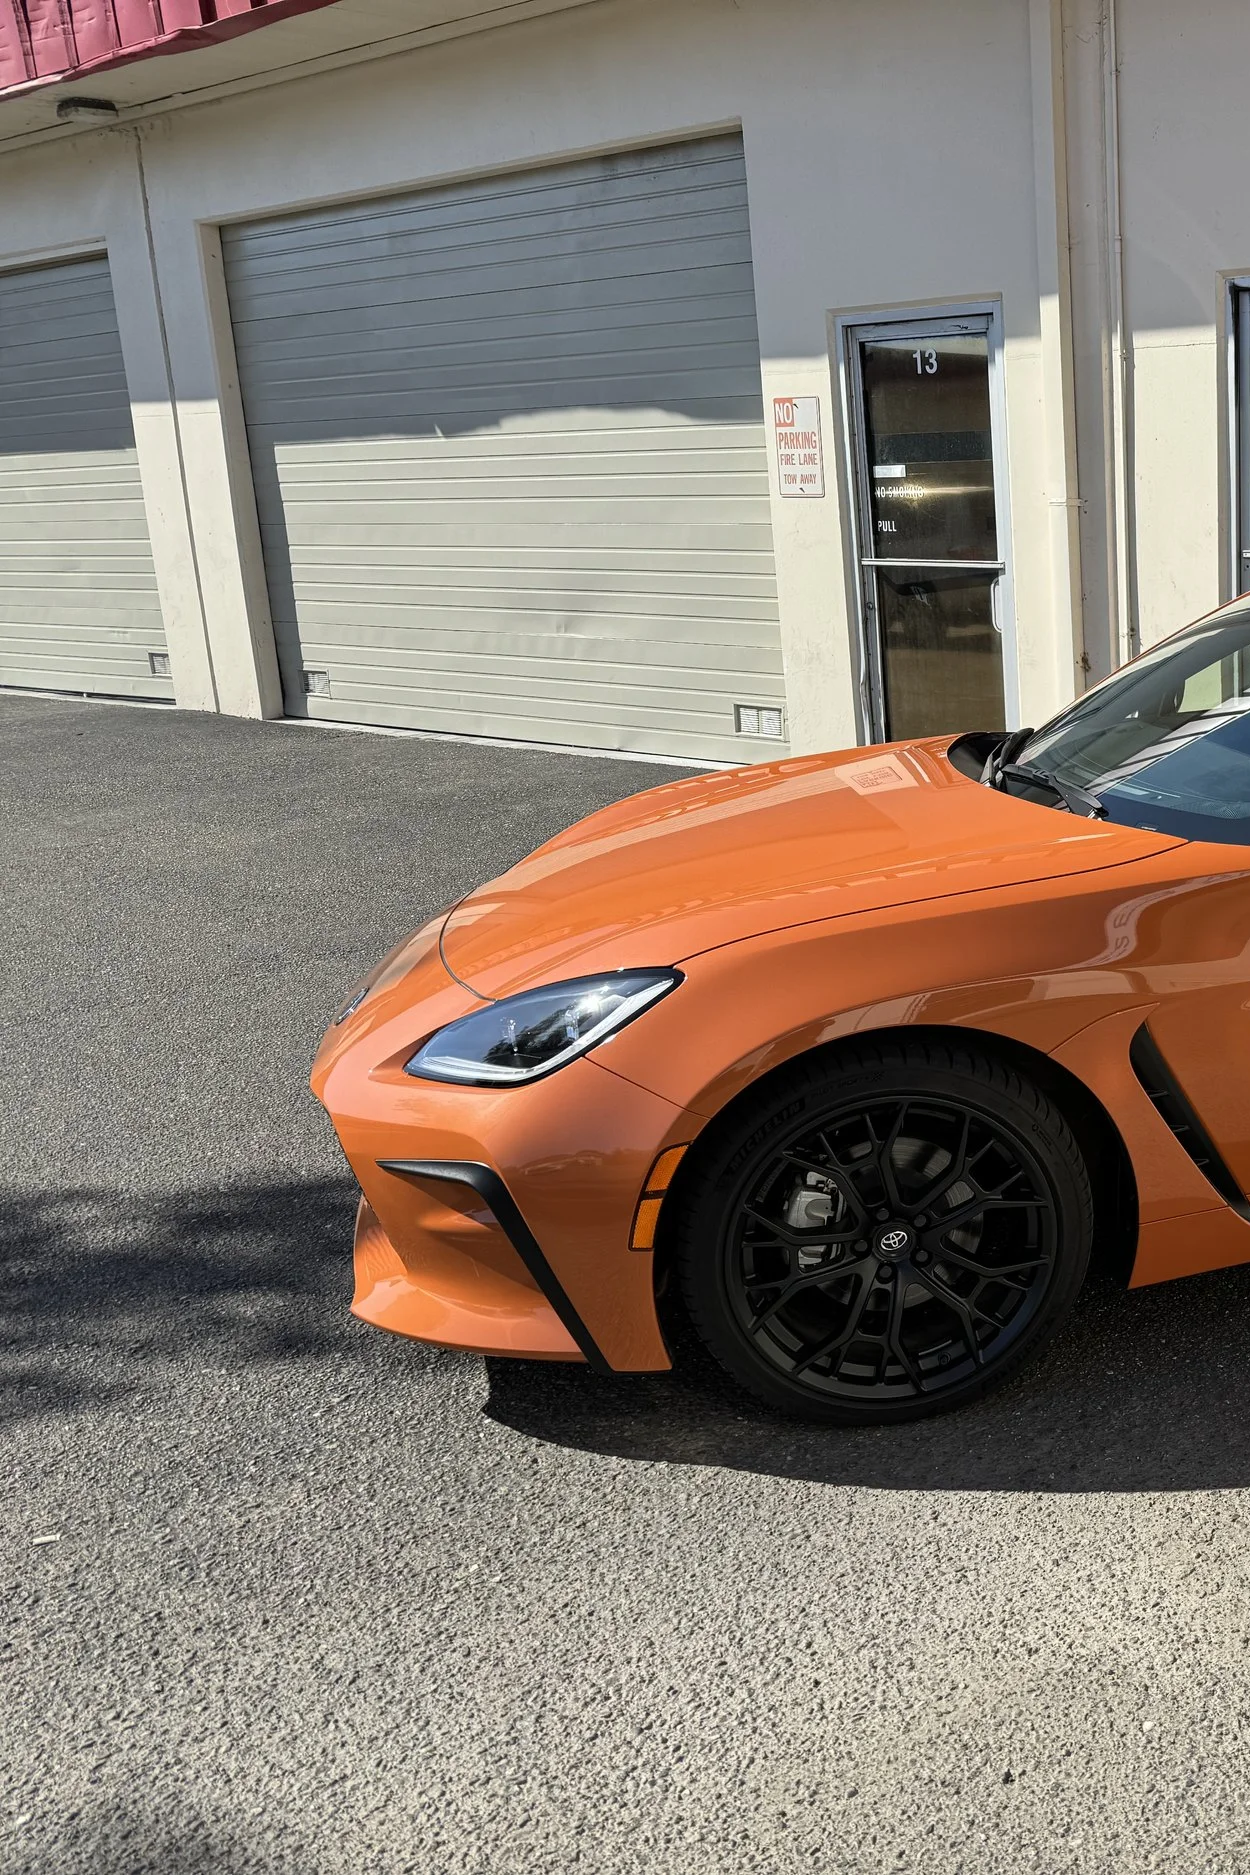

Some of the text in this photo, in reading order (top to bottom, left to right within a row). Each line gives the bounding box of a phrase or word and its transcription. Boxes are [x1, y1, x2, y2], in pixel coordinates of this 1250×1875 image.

[912, 348, 939, 375] 13
[775, 402, 793, 424] NO
[778, 431, 817, 450] PARKING
[780, 453, 818, 465] FIRE LANE
[783, 473, 817, 485] TOW AWAY
[875, 486, 886, 498] NO
[877, 520, 897, 532] PULL
[729, 1100, 803, 1174] MICHELIN
